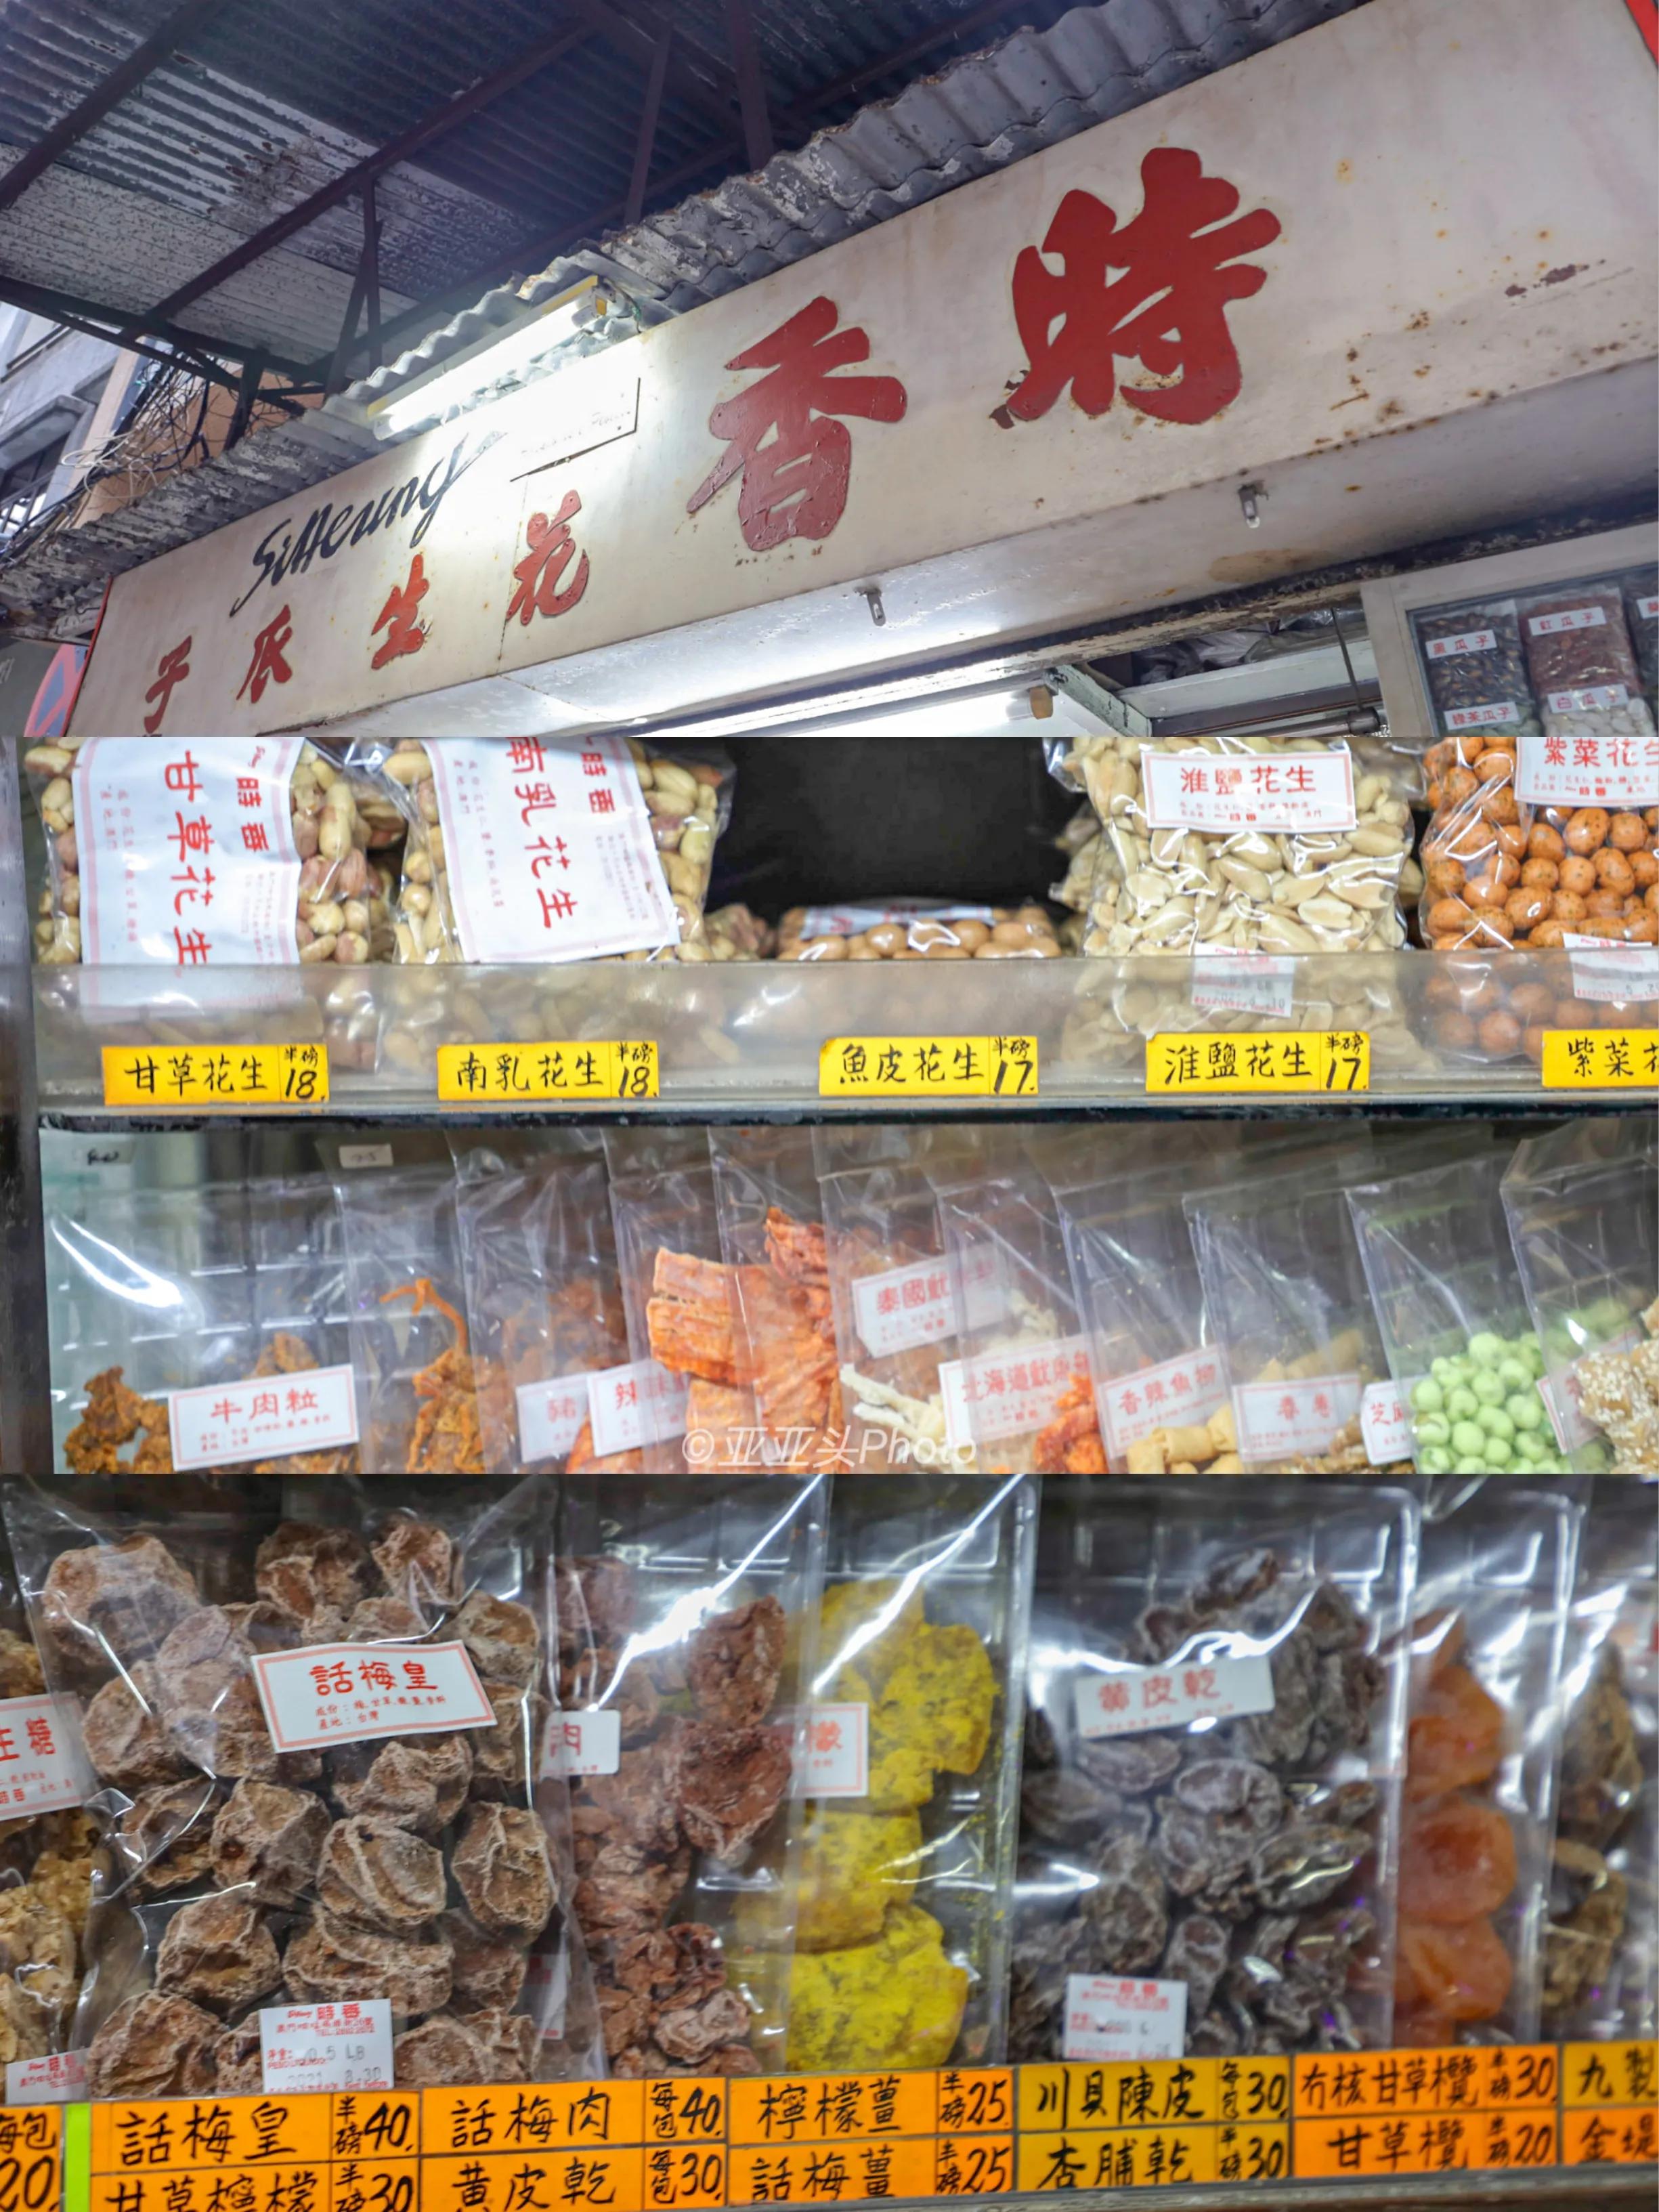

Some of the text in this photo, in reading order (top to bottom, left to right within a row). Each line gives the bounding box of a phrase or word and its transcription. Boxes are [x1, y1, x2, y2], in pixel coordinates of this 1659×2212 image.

[1432, 633, 1490, 654] 黑瓜子
[1539, 612, 1595, 630] 紅瓜子
[1180, 765, 1316, 795] 淮鹽花生
[165, 750, 216, 965] 甘草花生
[505, 737, 579, 930] 南乳花生
[616, 1041, 654, 1064] 半磅
[840, 1042, 985, 1084] 魚皮花生
[992, 1037, 1031, 1059] 半磅
[1165, 1038, 1314, 1085] 淮鹽花生
[1324, 1032, 1365, 1050] 半磅
[125, 1053, 268, 1098] 甘草花生
[457, 1051, 604, 1092] 南乳花生
[210, 1388, 318, 1424] 牛肉粒
[309, 1659, 438, 1696] 話梅皇
[939, 2069, 966, 2129] 半磅
[1037, 2062, 1206, 2131] 川貝陳皮
[1218, 2059, 1243, 2121] 每包
[1488, 2047, 1513, 2100] 半磅
[114, 2100, 298, 2165] 話梅皇
[332, 2096, 364, 2156] 半磅
[450, 2086, 611, 2148] 話梅肉
[650, 2081, 679, 2139] 每包
[758, 2074, 902, 2140] 檸檬薑
[1036, 2133, 1194, 2190] 杏脯乾
[1218, 2125, 1242, 2182] 半磅
[1327, 2116, 1469, 2173] 甘草欖
[1487, 2114, 1511, 2167] 半磅
[104, 2171, 321, 2212] 甘草檸檬
[648, 2149, 676, 2205] 每包
[749, 2143, 895, 2205] 話梅薑
[936, 2143, 963, 2194] 半磅
